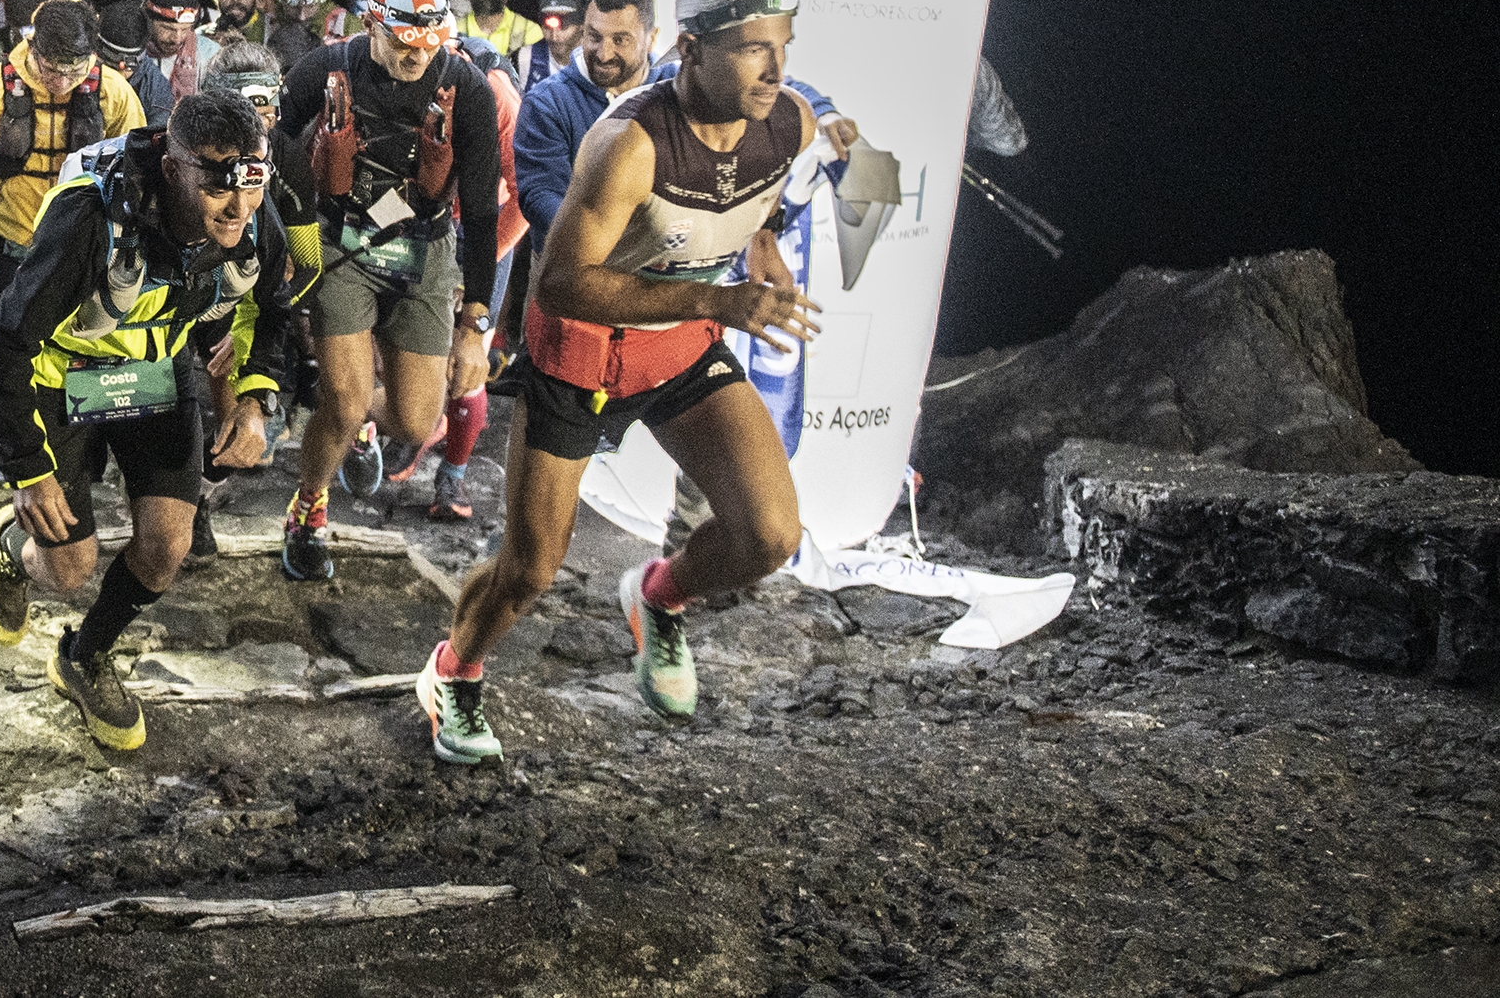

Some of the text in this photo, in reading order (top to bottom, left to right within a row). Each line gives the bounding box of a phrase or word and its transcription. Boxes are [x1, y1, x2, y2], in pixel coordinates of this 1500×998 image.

[900, 226, 929, 239] HORTA
[99, 372, 138, 387] Costa
[112, 395, 132, 408] 102
[828, 405, 892, 438] Açores
